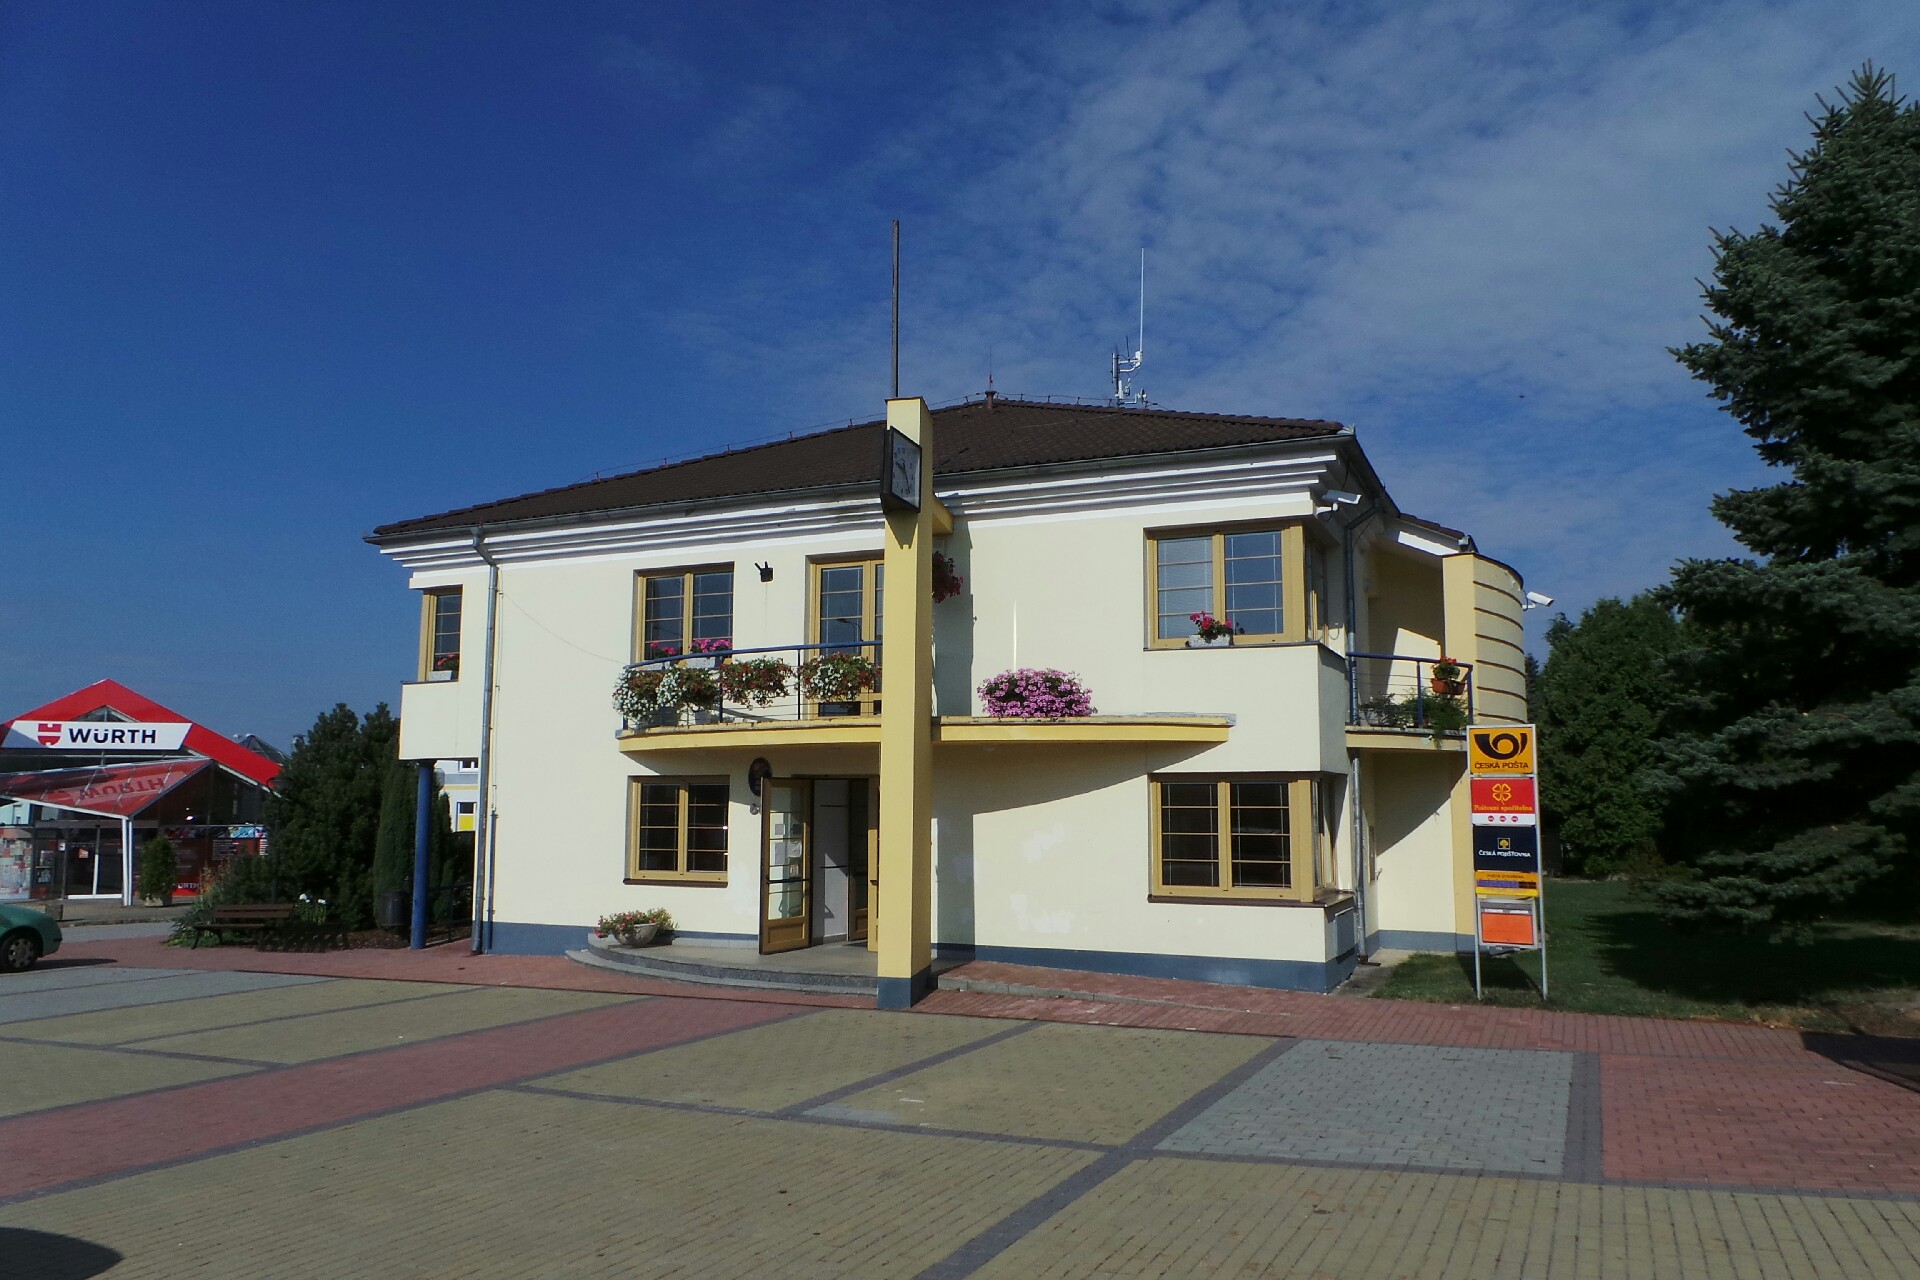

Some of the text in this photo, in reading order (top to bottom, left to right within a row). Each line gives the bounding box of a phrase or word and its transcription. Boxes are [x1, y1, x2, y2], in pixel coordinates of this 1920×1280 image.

[69, 728, 156, 744] WÜRTH
[1474, 761, 1529, 769] ČESKÁ POŠTA
